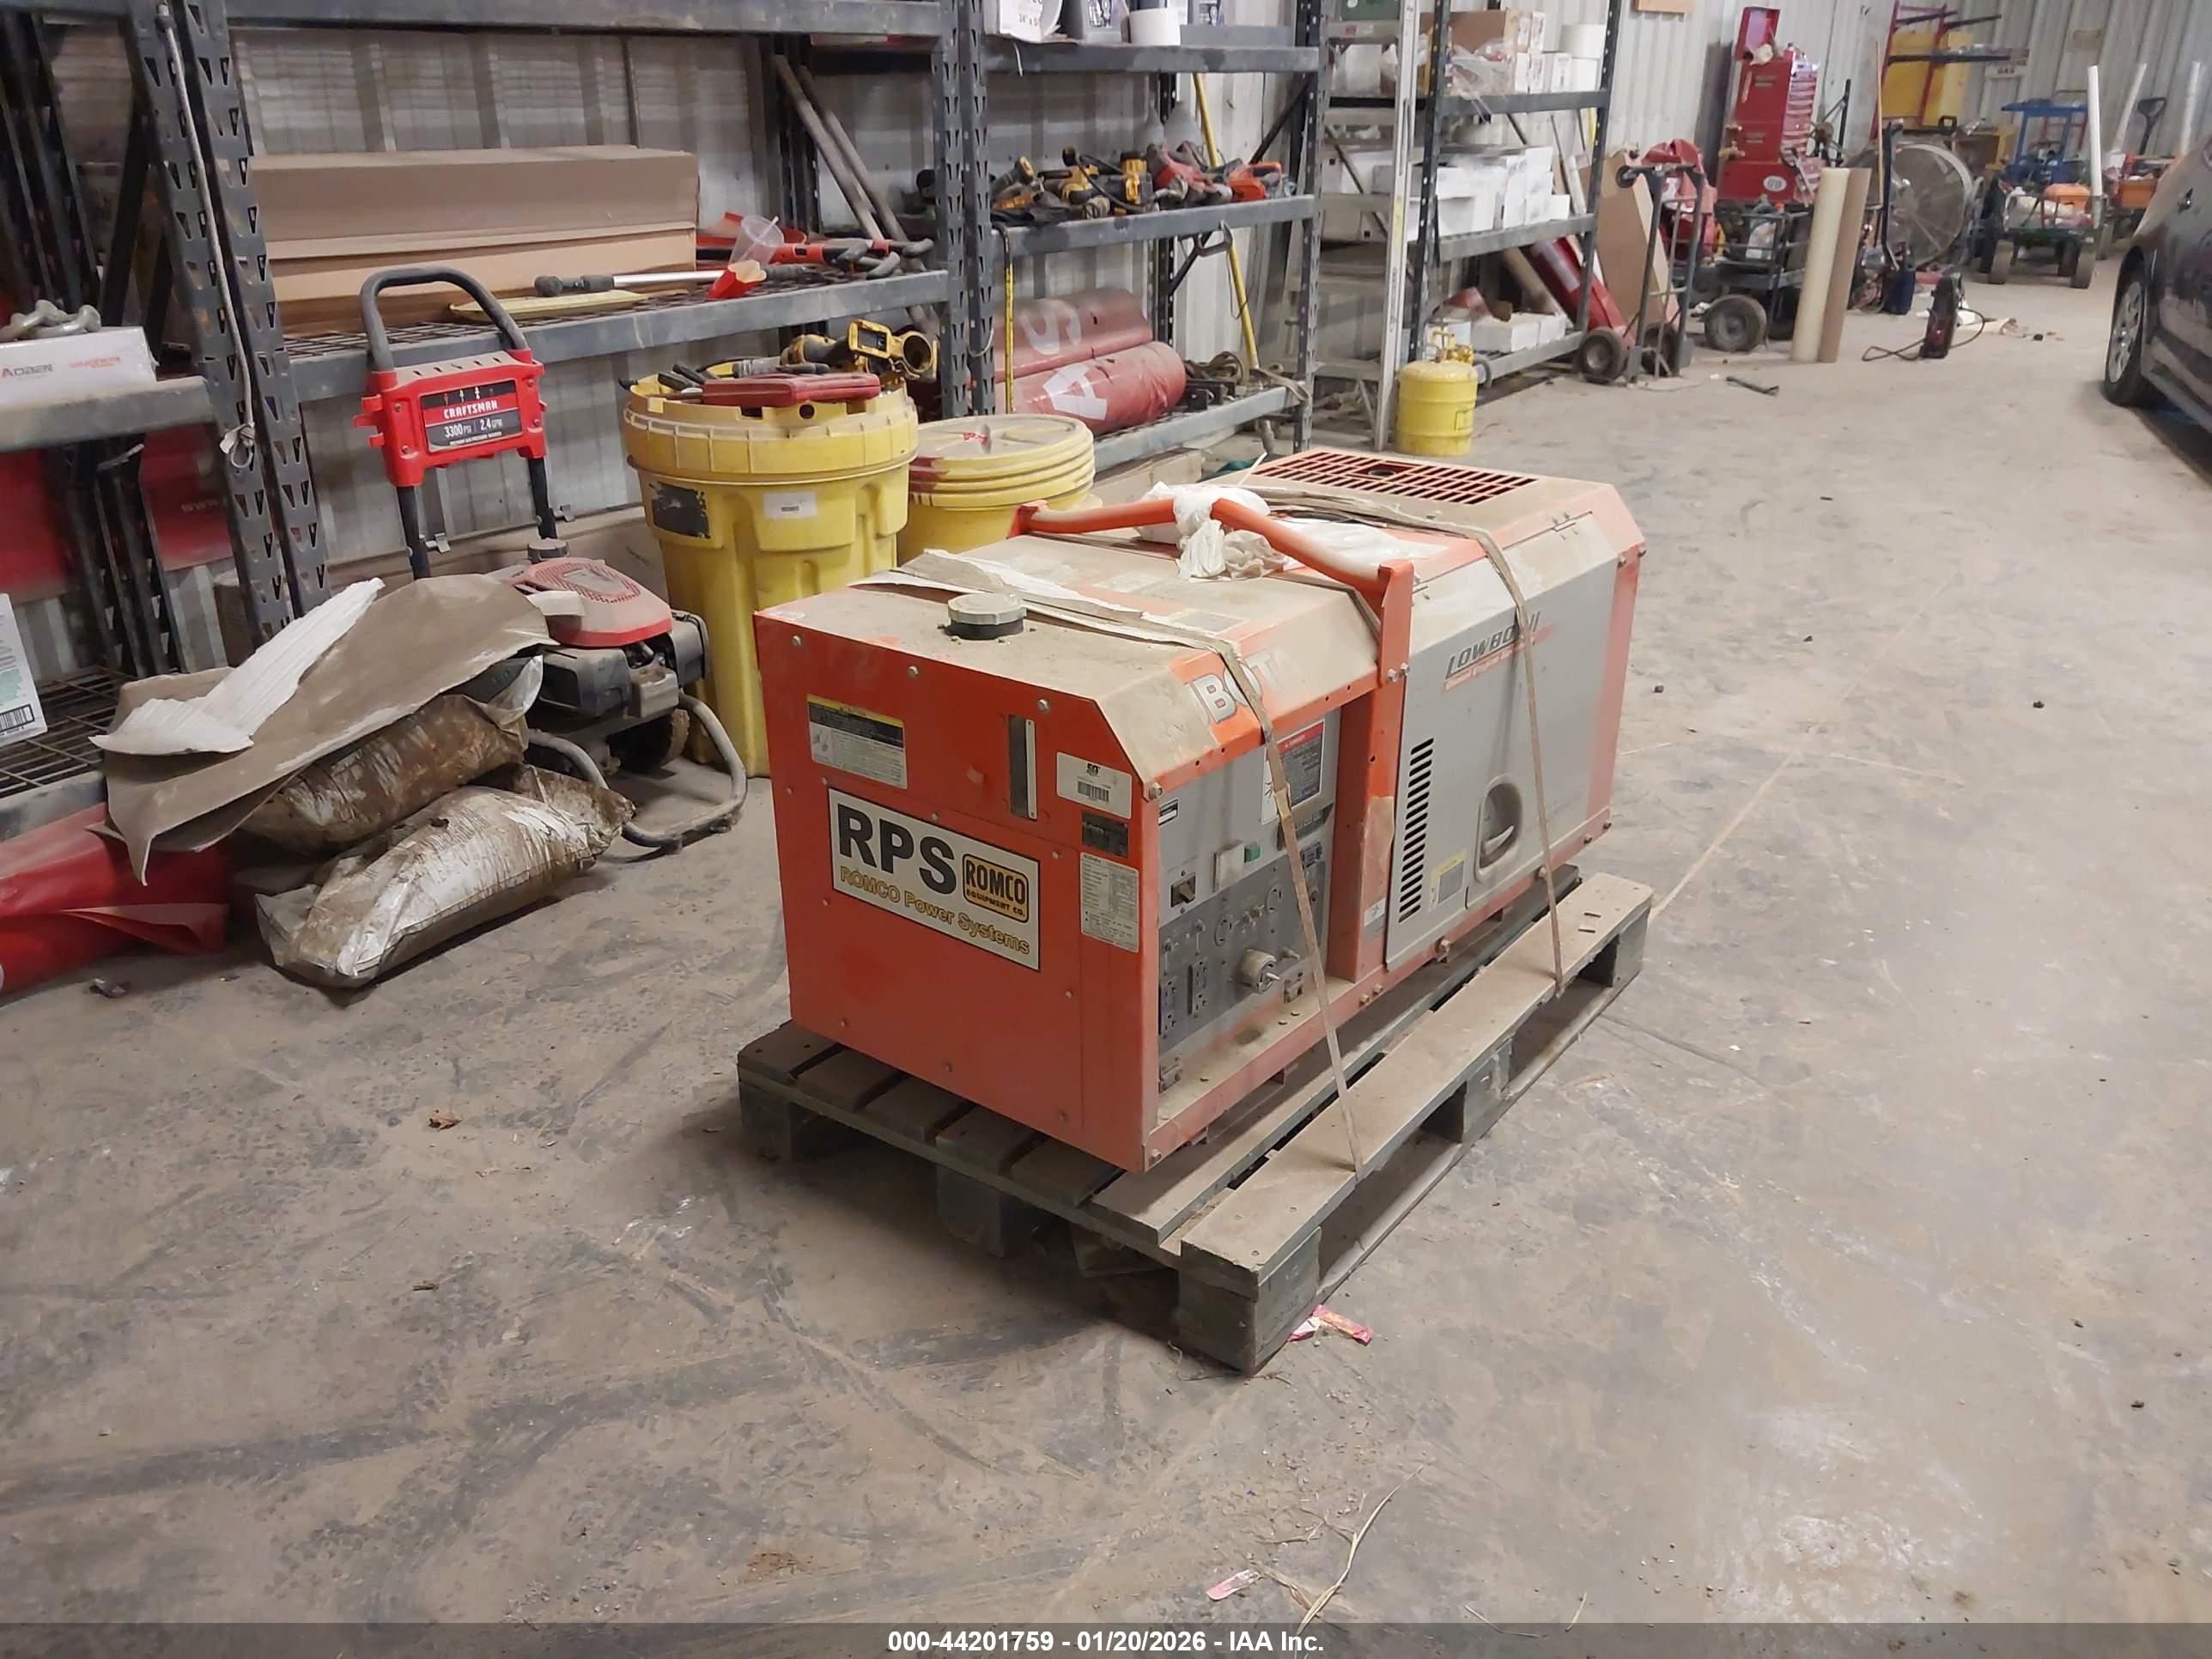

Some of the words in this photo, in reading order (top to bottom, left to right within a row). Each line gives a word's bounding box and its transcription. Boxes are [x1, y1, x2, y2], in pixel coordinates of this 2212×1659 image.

[443, 399, 498, 420] CRAFTSMAN
[444, 423, 464, 439] 3300
[479, 417, 491, 432] 2.4
[1444, 624, 1526, 680] LOWBO
[837, 803, 957, 895] RPS
[965, 860, 1026, 905] ROMCO
[966, 889, 1011, 911] EQUIPMENT
[1012, 906, 1025, 917] CO.
[840, 866, 901, 902] ROMCO
[904, 890, 955, 925] Power
[957, 913, 1030, 955] Systems
